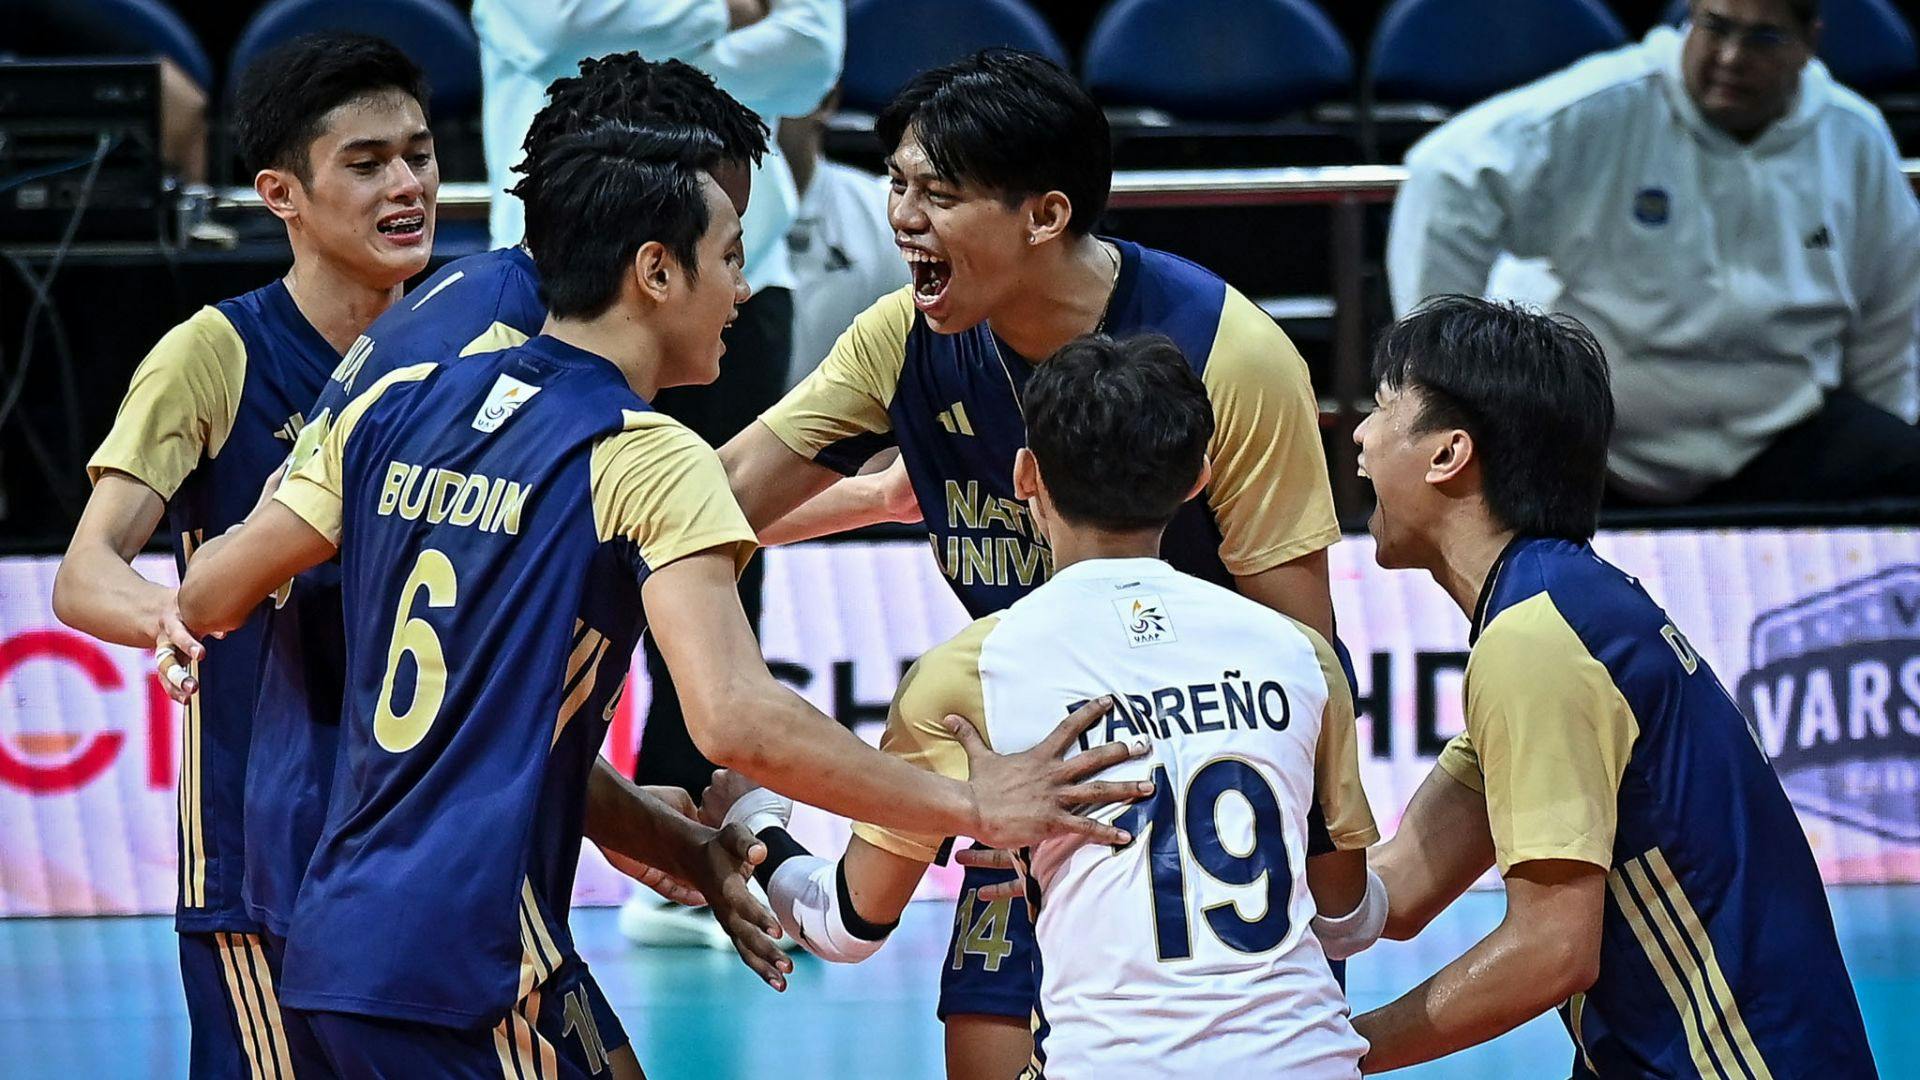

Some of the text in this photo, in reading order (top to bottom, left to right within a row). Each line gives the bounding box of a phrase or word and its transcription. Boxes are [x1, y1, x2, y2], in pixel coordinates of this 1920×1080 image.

[377, 460, 533, 535] BUDDIN
[373, 548, 458, 754] 6
[952, 888, 1013, 972] 14
[1109, 754, 1295, 963] 19
